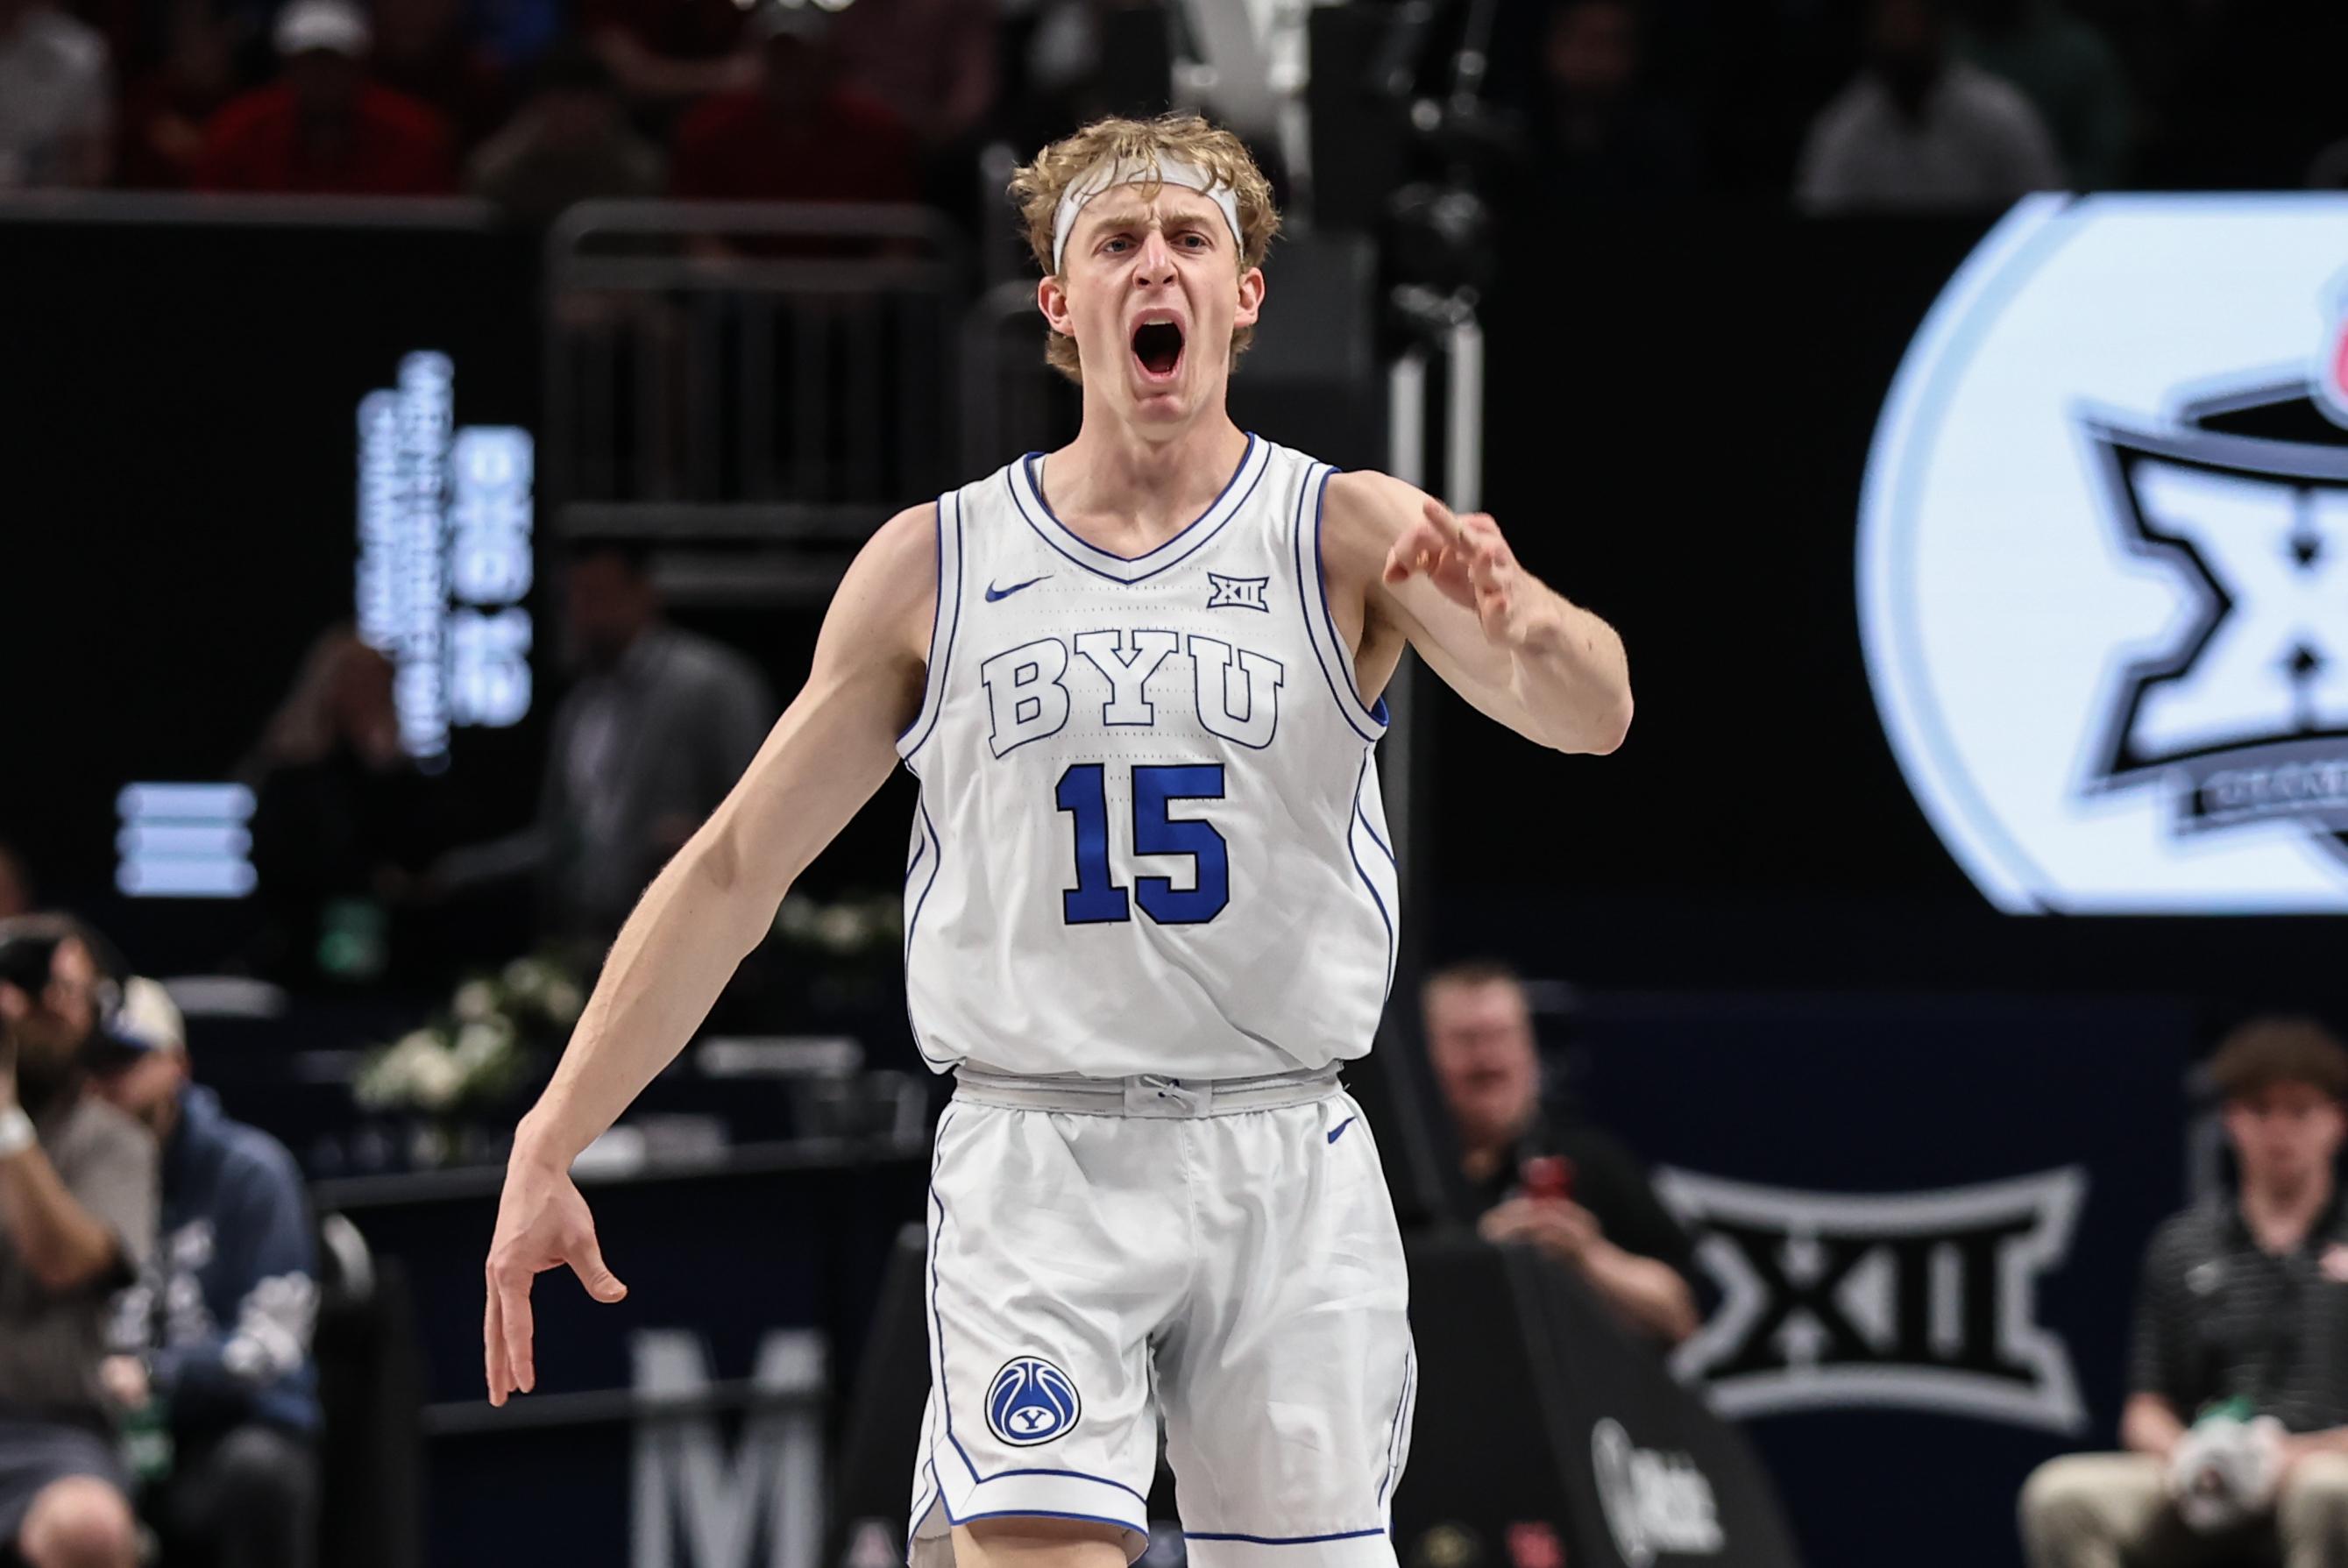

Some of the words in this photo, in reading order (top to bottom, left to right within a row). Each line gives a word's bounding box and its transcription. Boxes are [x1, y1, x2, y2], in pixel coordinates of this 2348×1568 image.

[1206, 571, 1270, 613] XII
[980, 629, 1285, 760] BYU
[1054, 763, 1231, 926] 15
[1676, 1194, 2064, 1413] XII
[1017, 1409, 1046, 1430] Y
